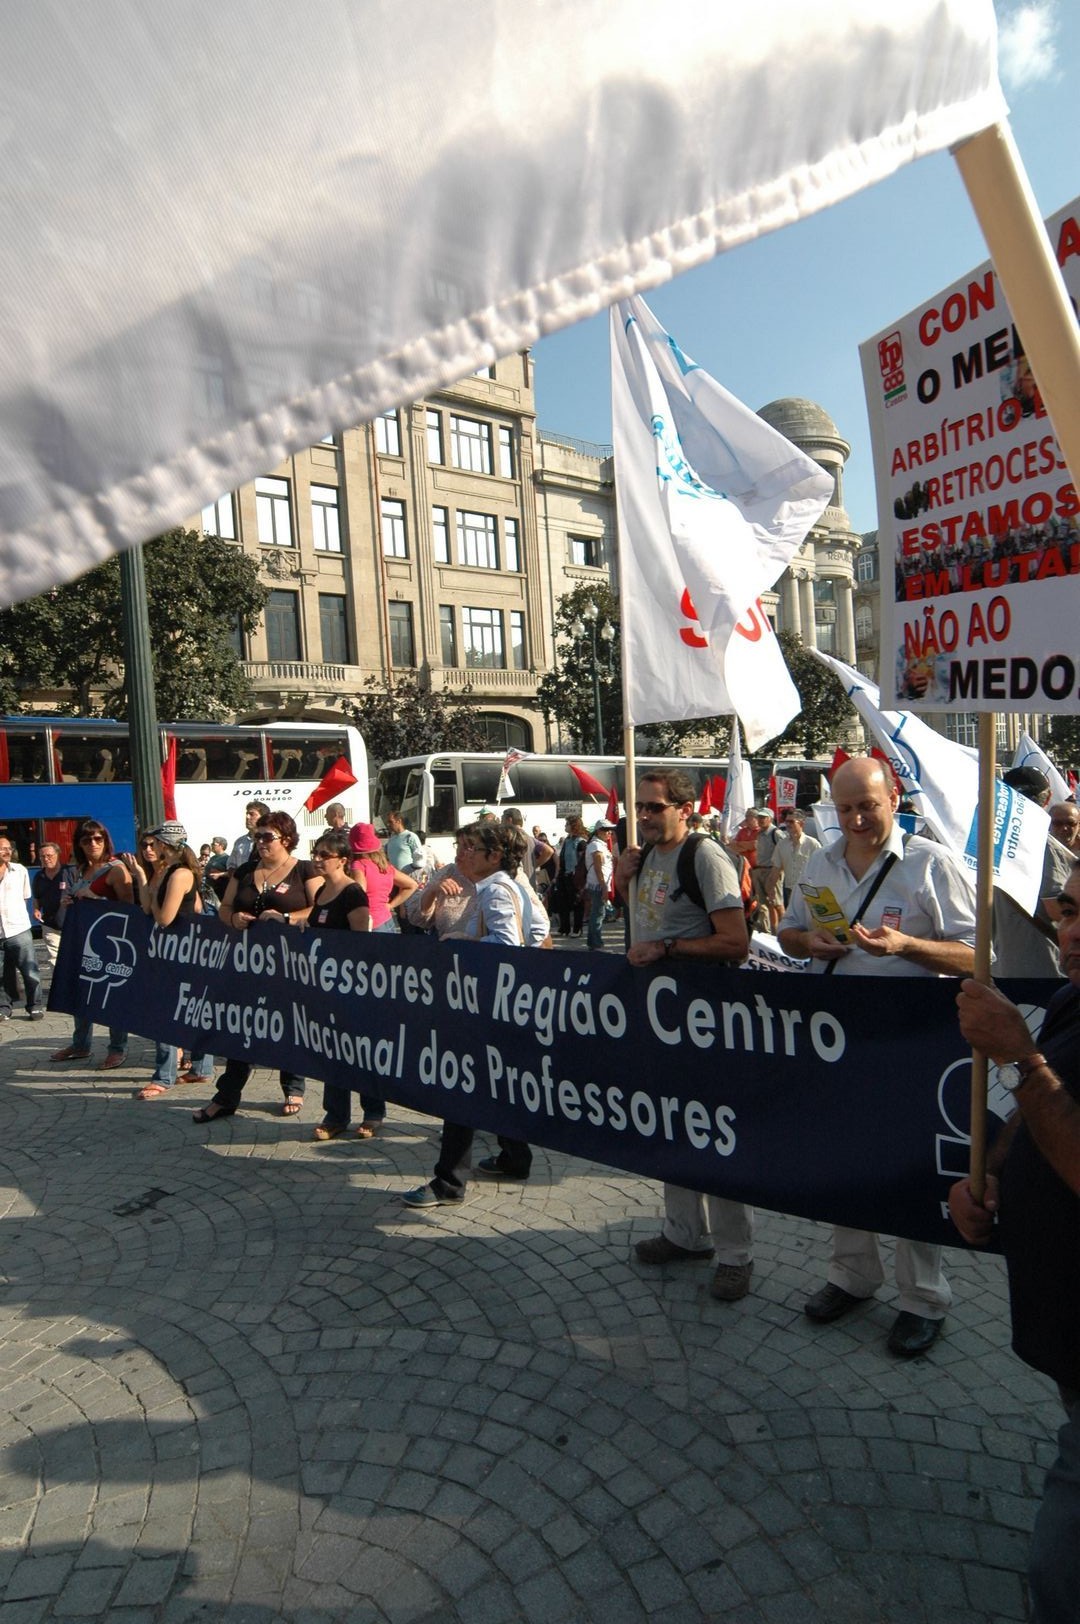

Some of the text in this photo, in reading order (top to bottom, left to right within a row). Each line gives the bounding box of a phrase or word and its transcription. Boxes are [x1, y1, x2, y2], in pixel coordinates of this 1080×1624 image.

[917, 369, 940, 404] O
[891, 397, 1022, 477] ARBÍTRIO
[903, 483, 1080, 557] ESTAMOS
[905, 569, 950, 601] EM
[904, 596, 1012, 660] NÃO AO
[949, 654, 1080, 701] MEDO
[233, 929, 276, 976] dos
[280, 937, 434, 1005] Professores
[446, 954, 480, 1014] da
[492, 962, 627, 1046] Região
[646, 975, 847, 1063] Centro
[173, 983, 737, 1157] Federação Nacional dos Professores
